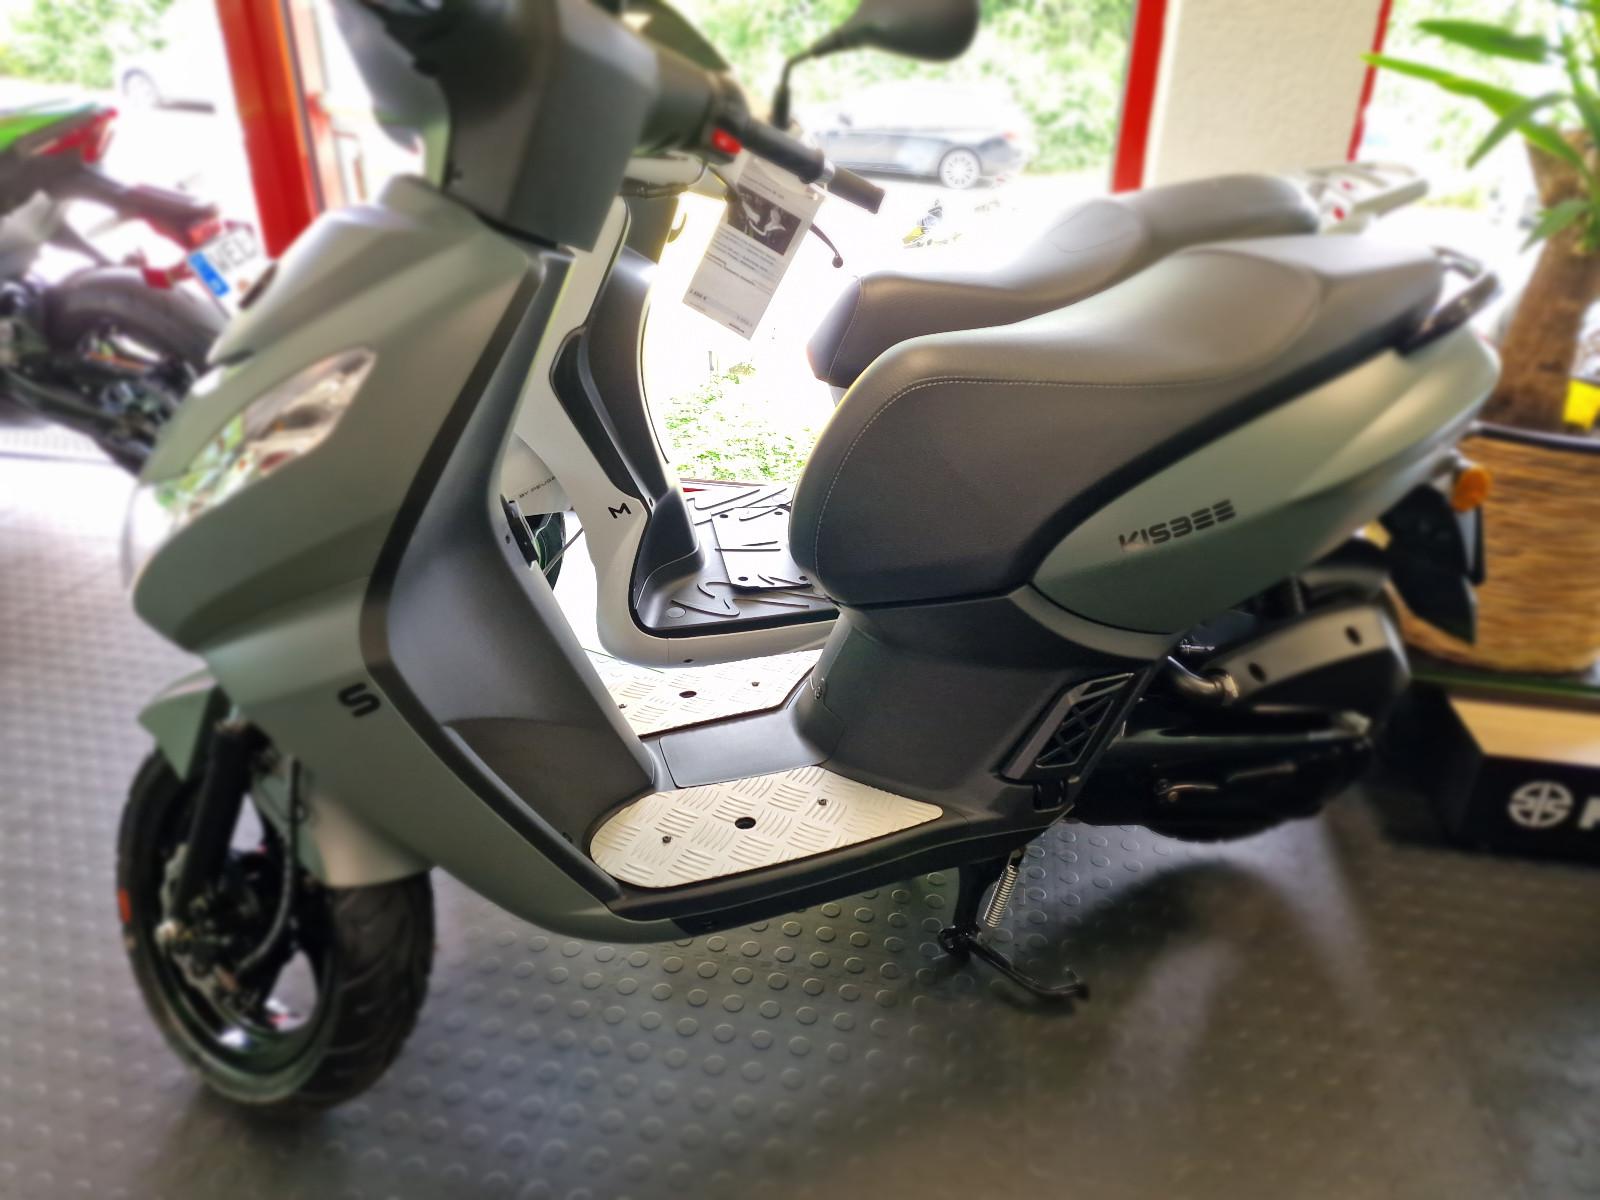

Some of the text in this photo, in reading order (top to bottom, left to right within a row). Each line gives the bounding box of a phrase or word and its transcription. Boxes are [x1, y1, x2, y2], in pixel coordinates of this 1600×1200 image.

[608, 503, 631, 519] M
[1118, 499, 1236, 551] KISBEE
[338, 682, 381, 718] S
